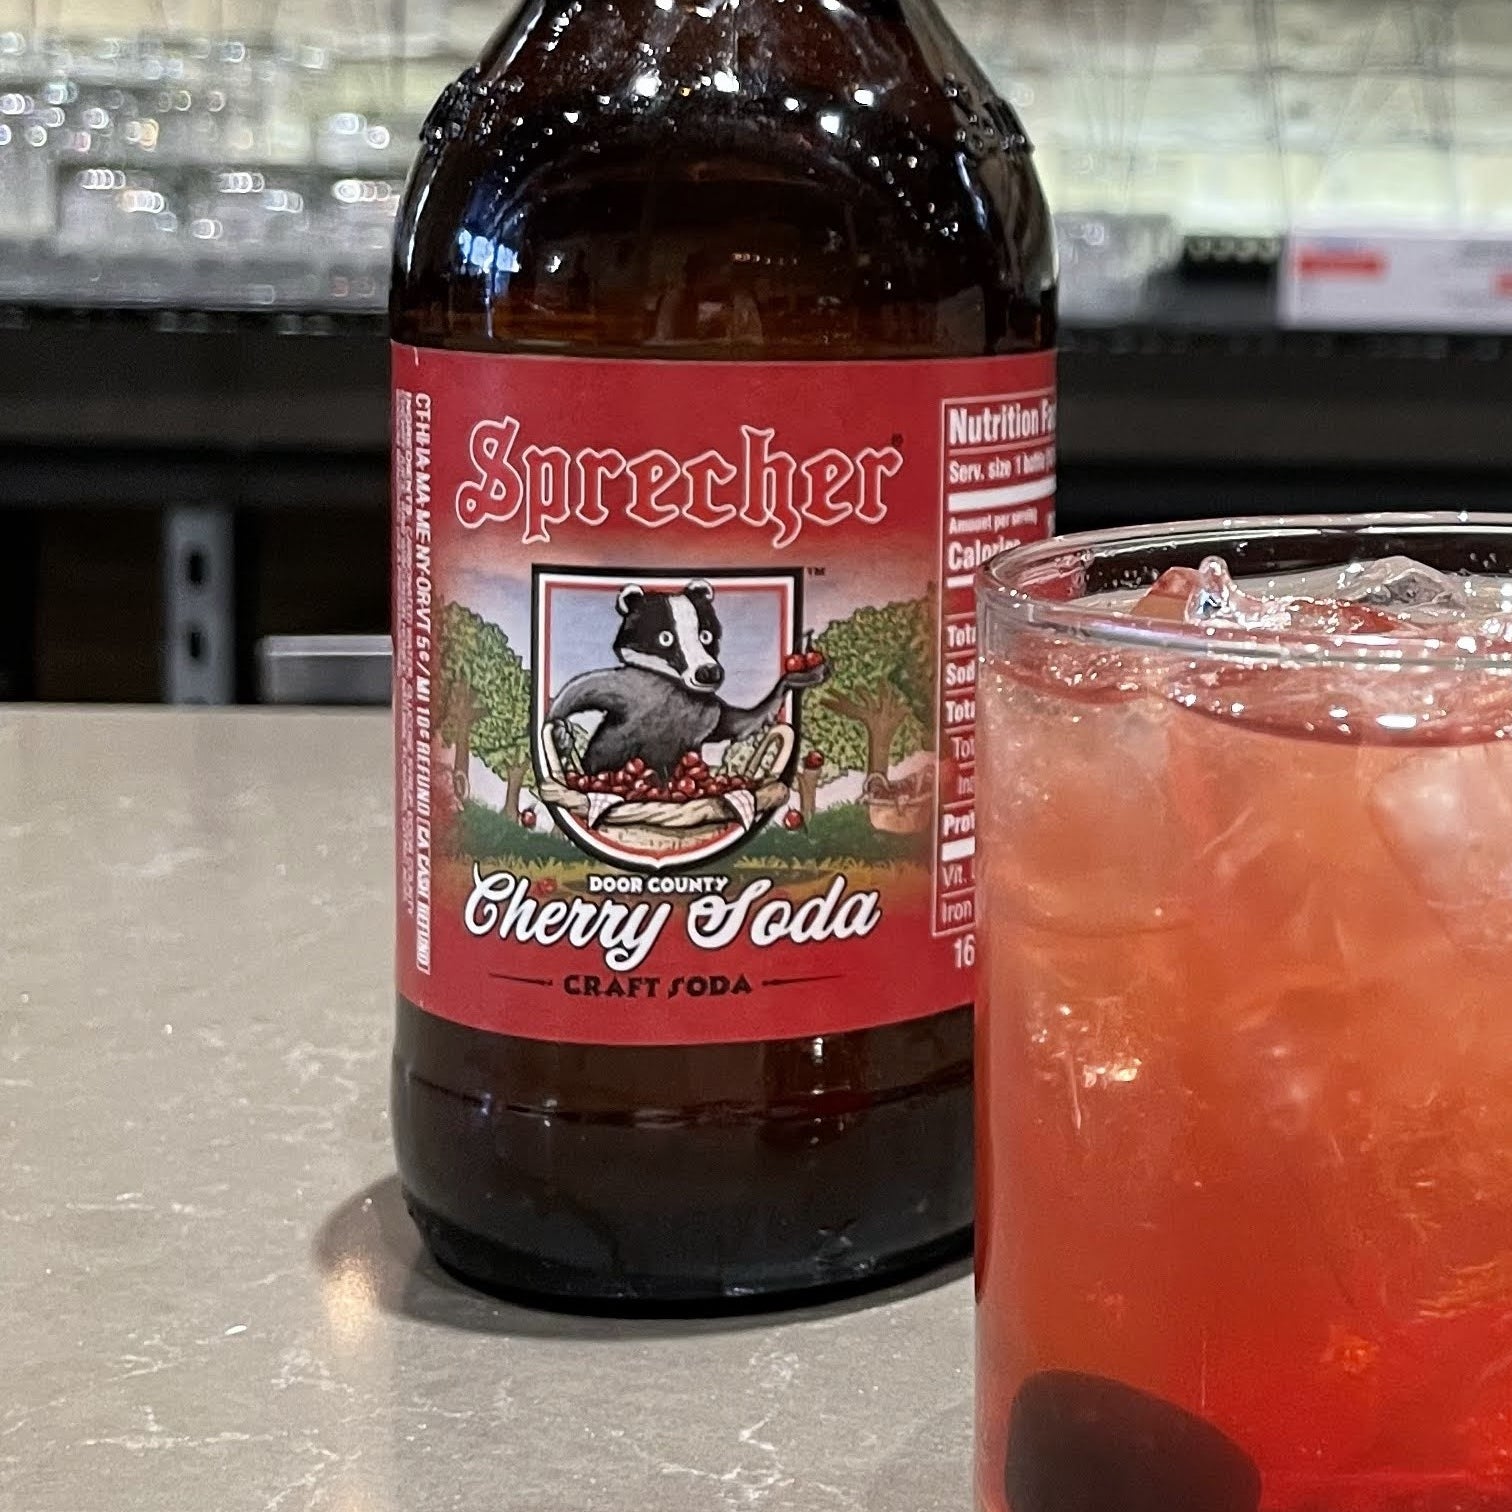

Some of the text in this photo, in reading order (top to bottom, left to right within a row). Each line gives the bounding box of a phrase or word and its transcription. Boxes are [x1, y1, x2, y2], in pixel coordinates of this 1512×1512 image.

[950, 402, 1039, 446] Nutrition
[456, 416, 903, 550] Sprecher
[949, 459, 985, 484] Serv.
[589, 875, 729, 893] DOOR COUNTY
[464, 863, 881, 972] Cherry Soda
[940, 899, 973, 924] Iron
[953, 933, 975, 969] 16
[563, 974, 753, 998] CRAFT SODA
